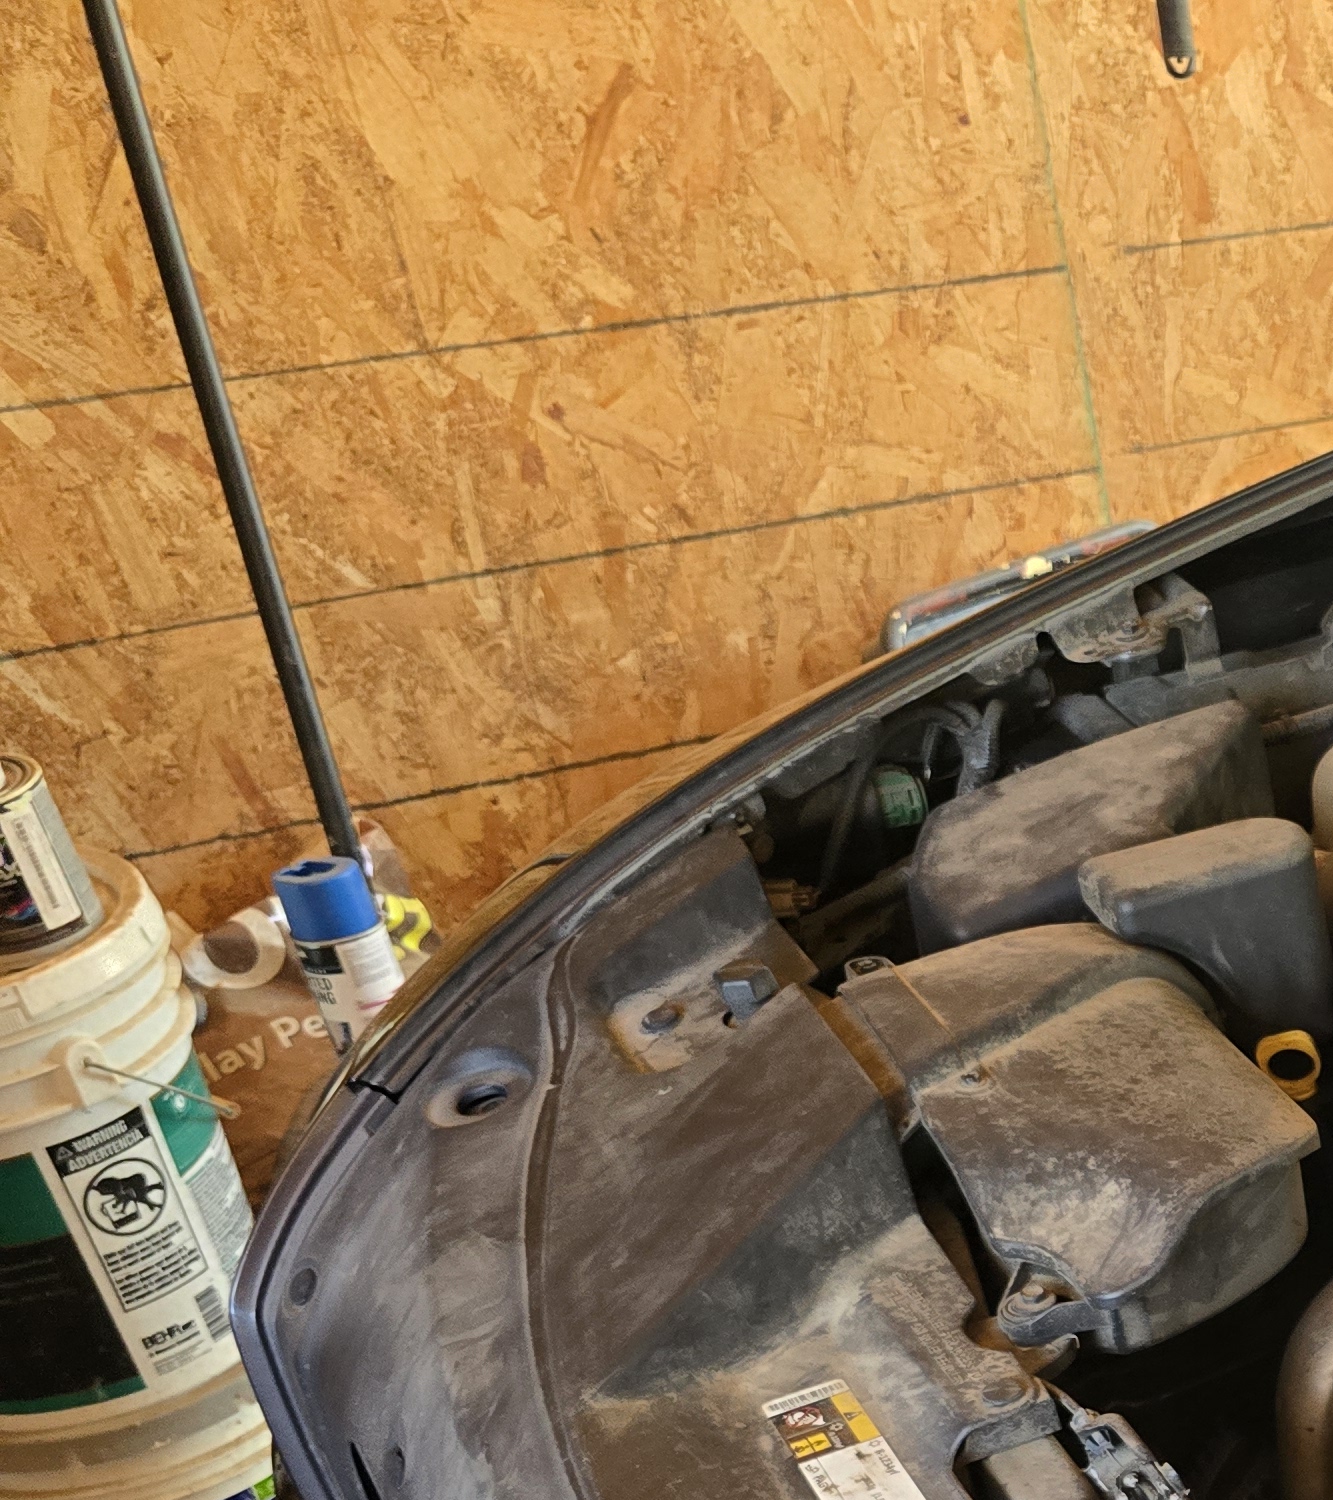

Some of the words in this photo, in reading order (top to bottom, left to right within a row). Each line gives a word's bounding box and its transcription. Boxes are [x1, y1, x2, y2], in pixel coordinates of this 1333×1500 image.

[198, 1035, 266, 1083] lay
[269, 1014, 330, 1049] Pe
[66, 1128, 144, 1174] ADVERTENCIA
[71, 1118, 129, 1152] WARNING
